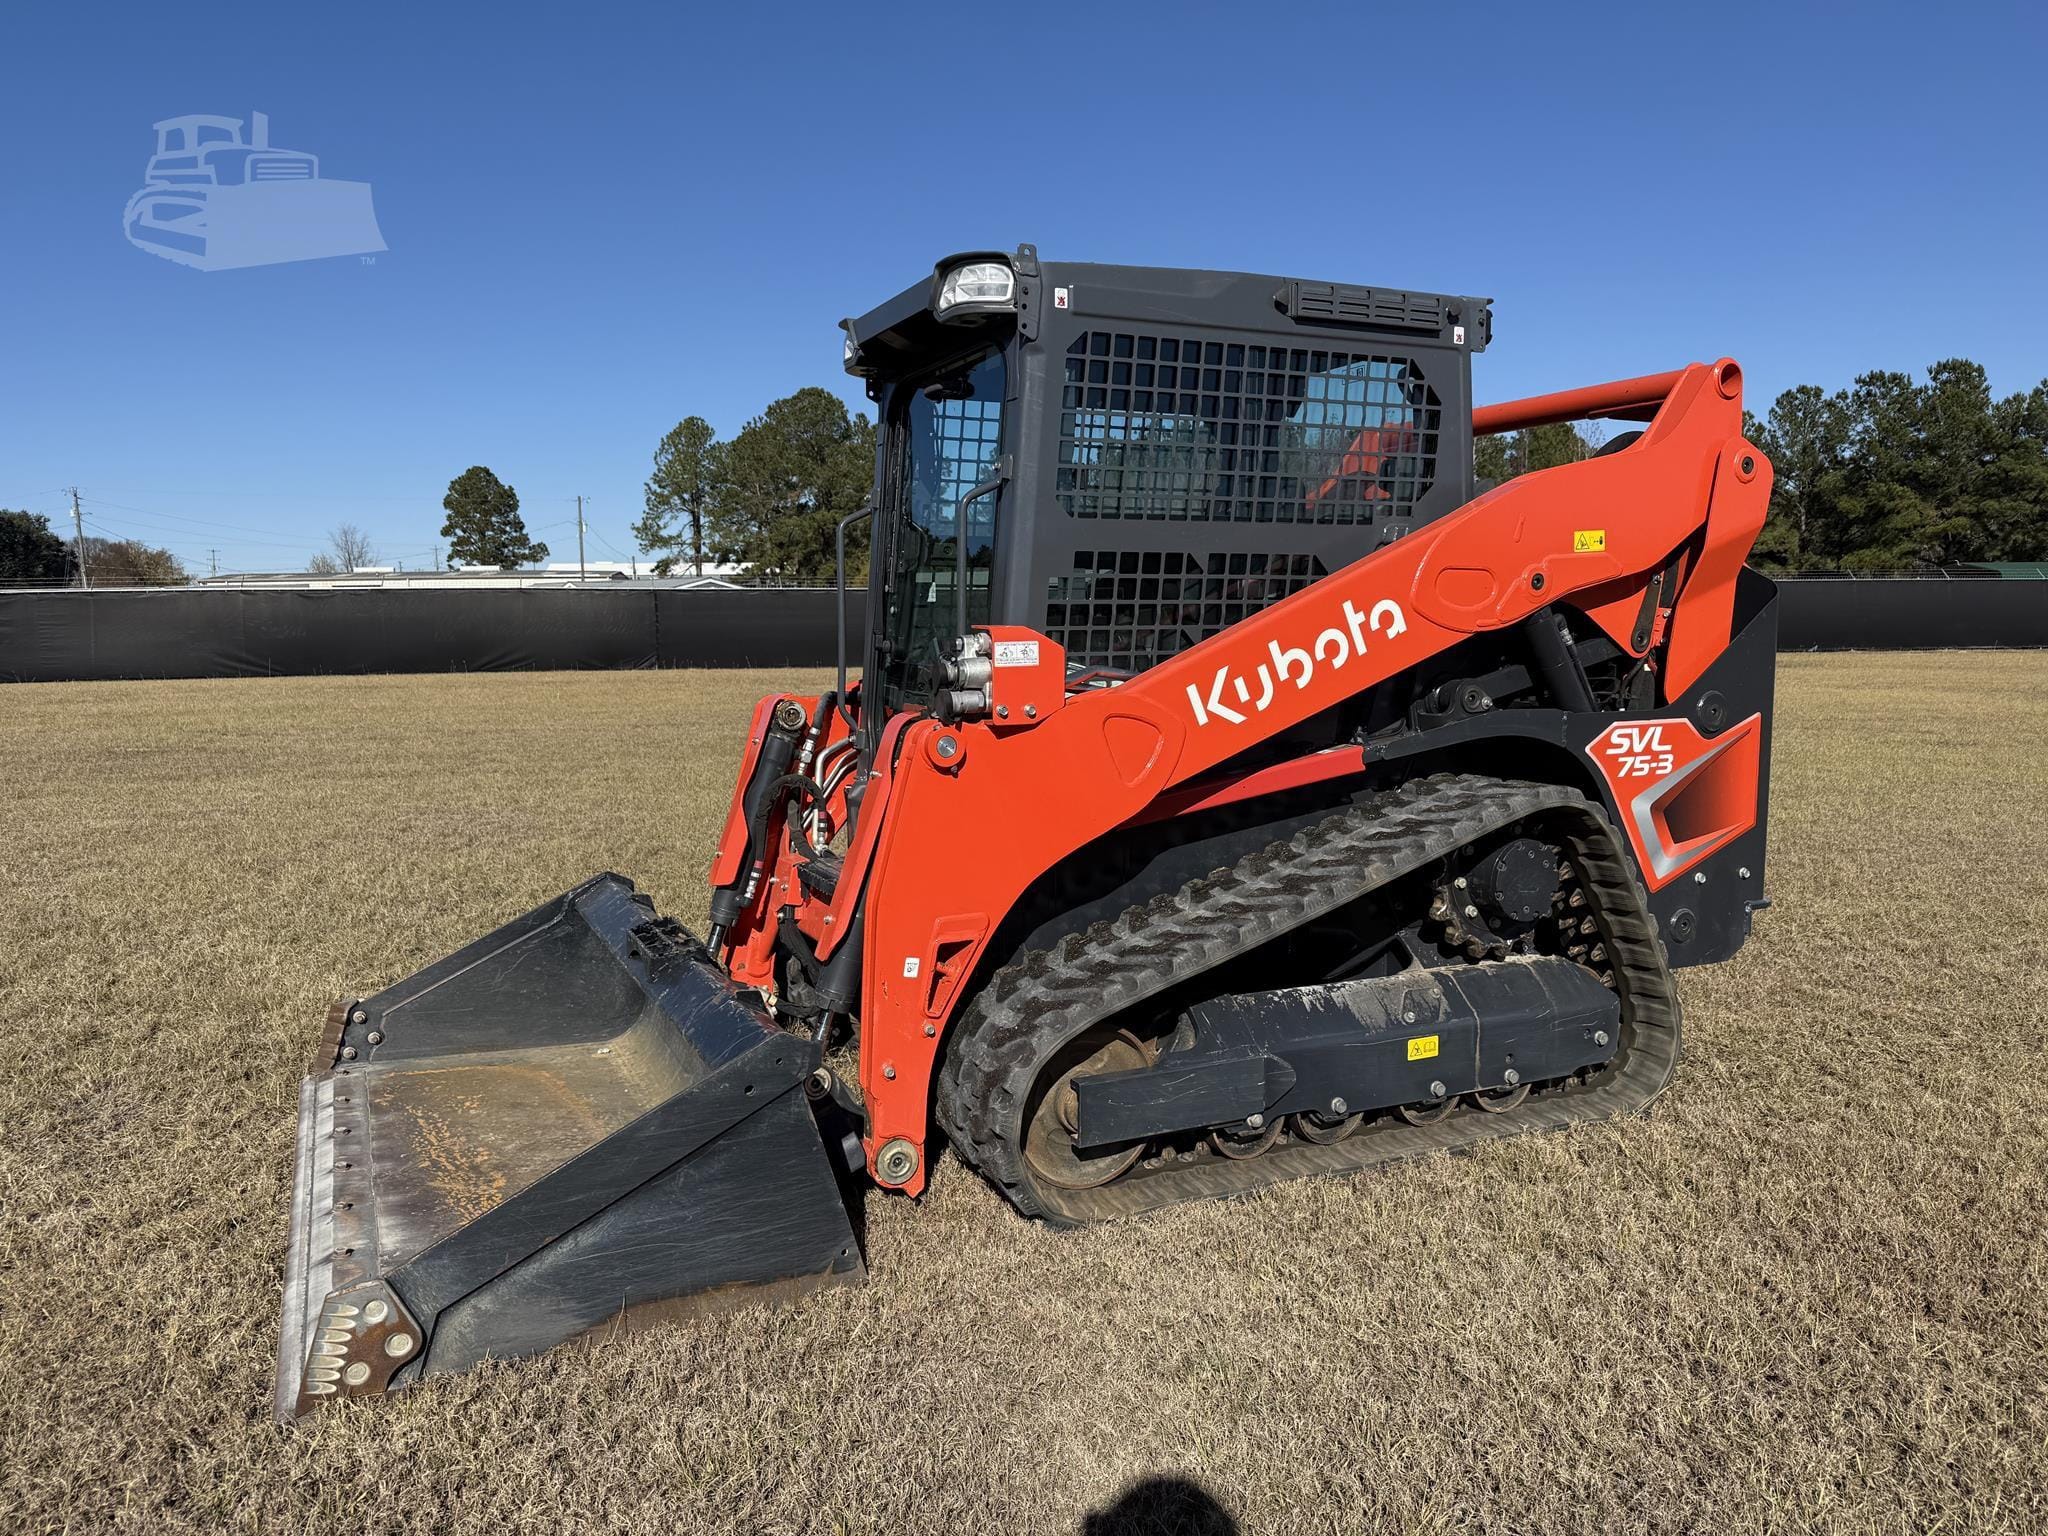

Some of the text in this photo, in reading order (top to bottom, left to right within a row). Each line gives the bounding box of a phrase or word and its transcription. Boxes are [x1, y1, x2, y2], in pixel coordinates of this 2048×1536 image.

[1186, 599, 1407, 727] Kubota
[1605, 726, 1673, 755] SVL
[1617, 753, 1674, 778] 75-3
